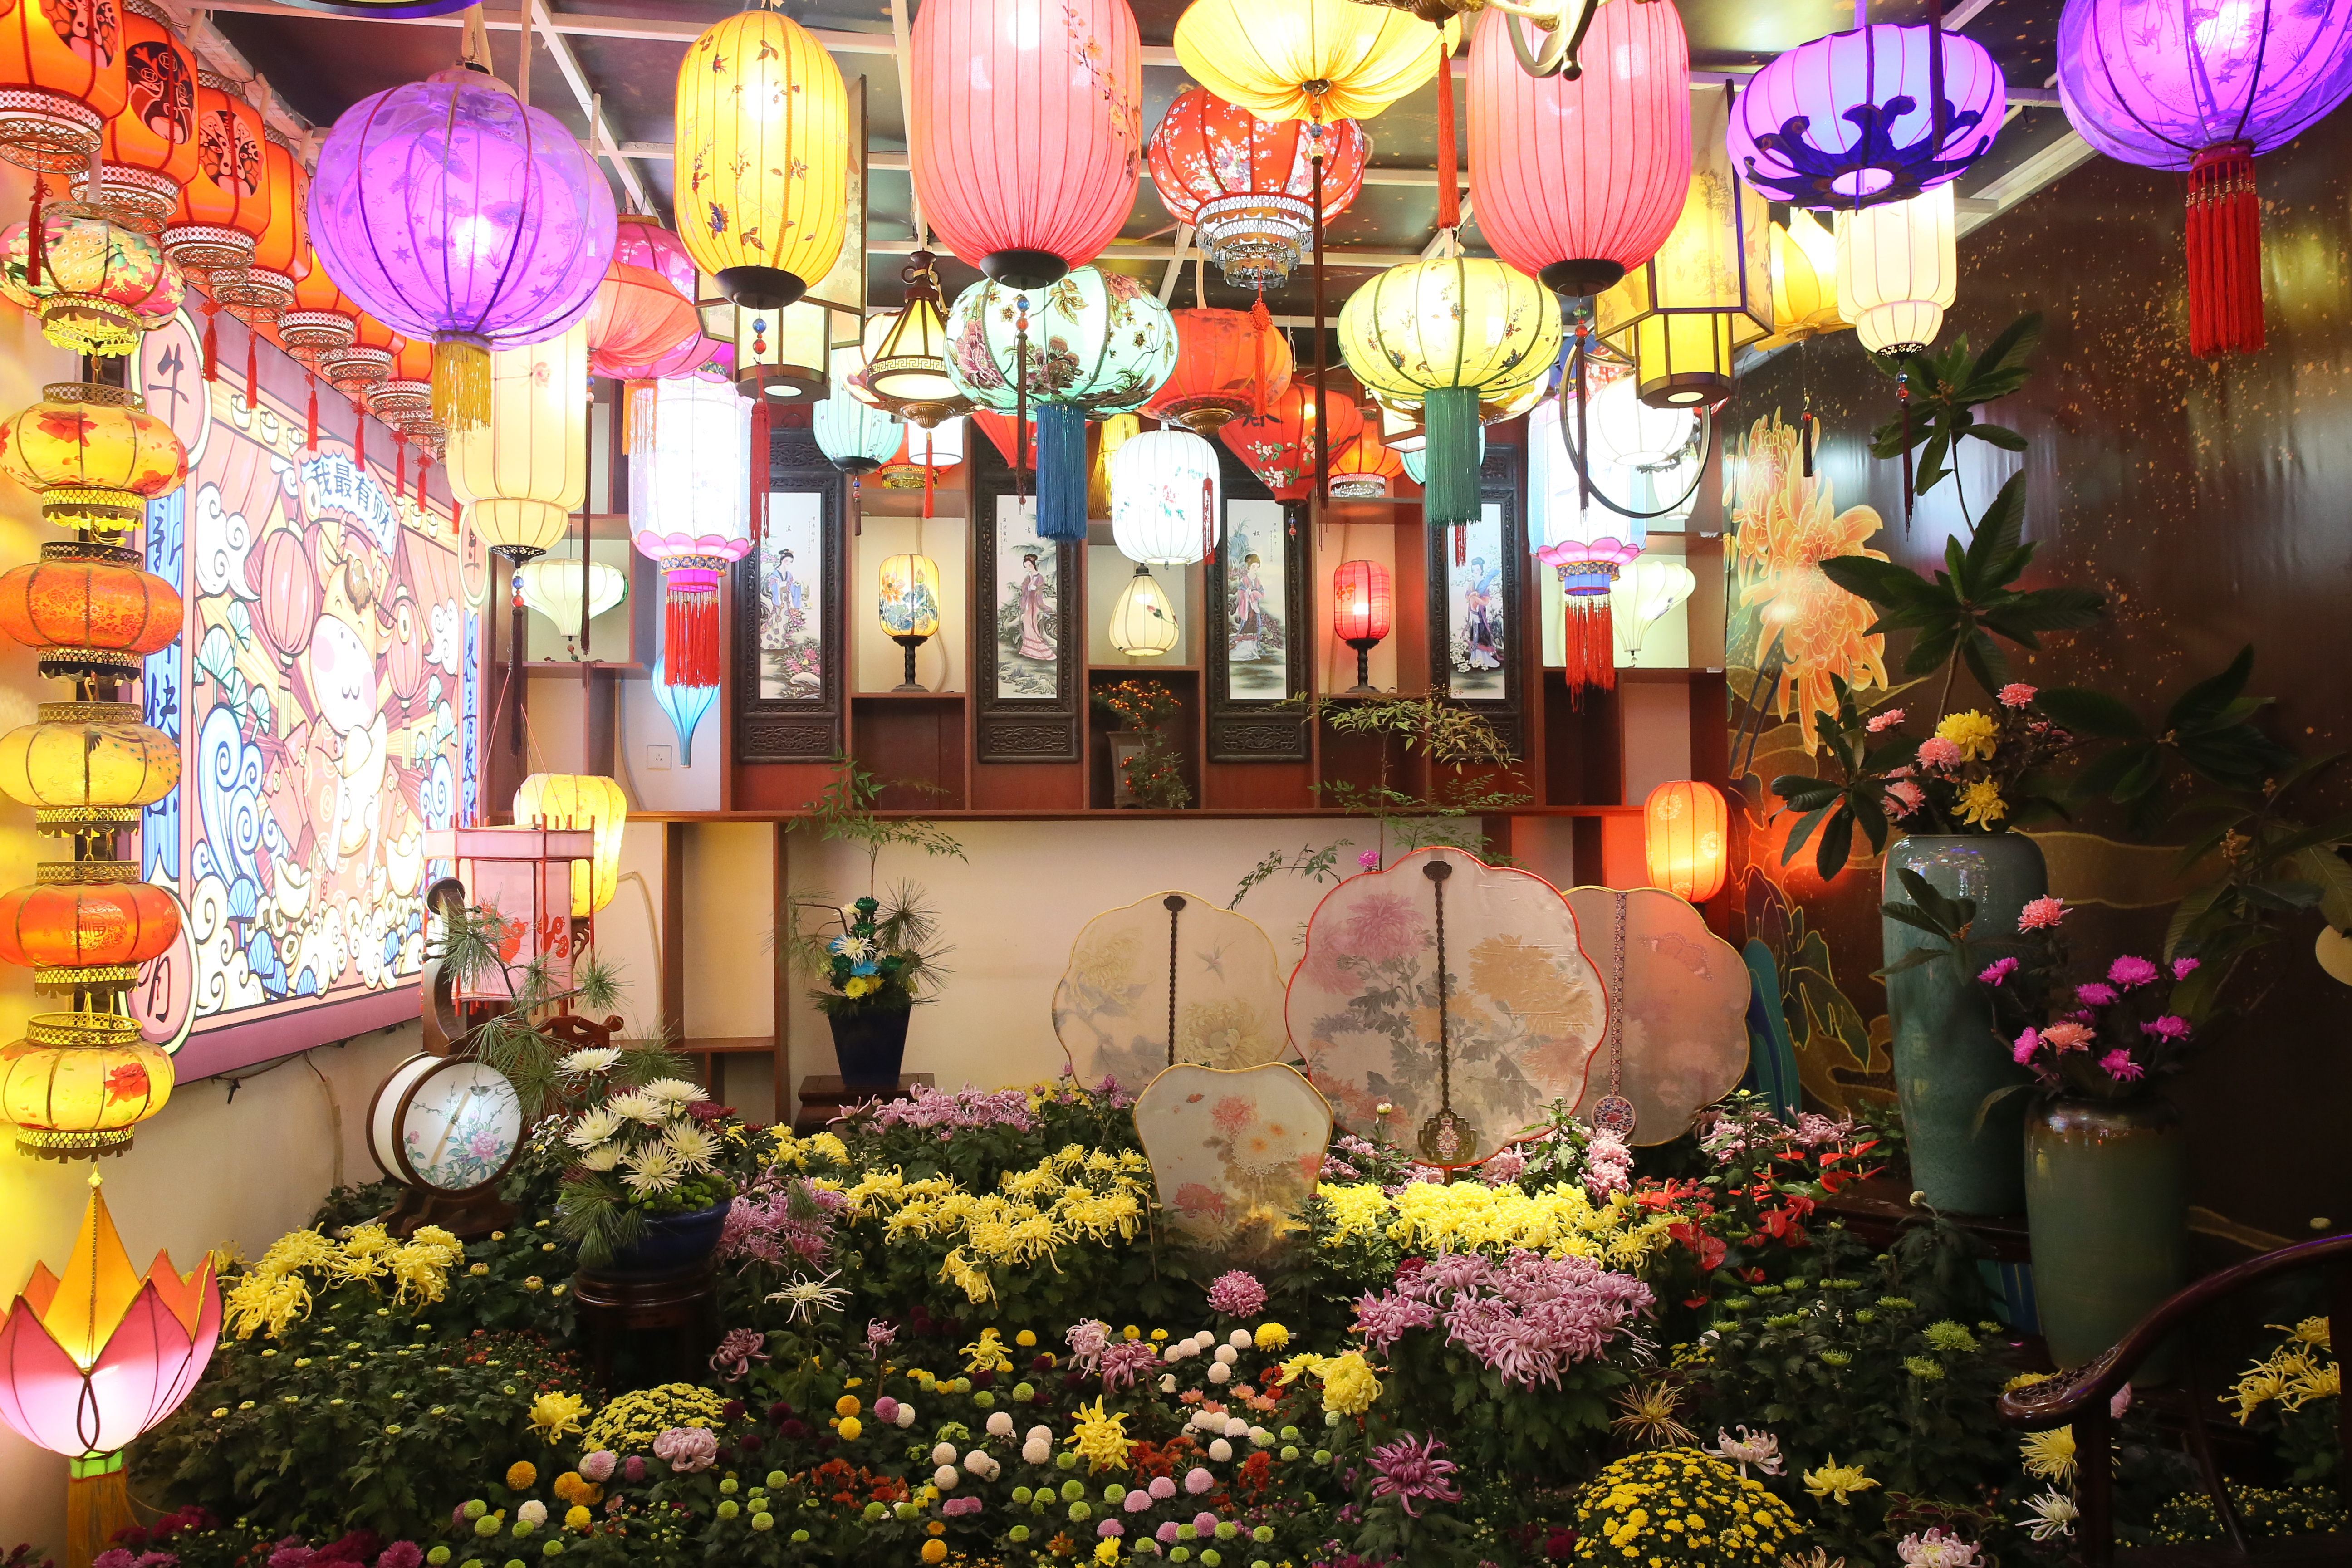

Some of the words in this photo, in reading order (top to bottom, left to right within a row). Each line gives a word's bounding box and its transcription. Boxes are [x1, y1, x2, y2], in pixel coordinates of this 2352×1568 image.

[147, 343, 189, 430] 牛
[311, 461, 389, 536] 我最有财
